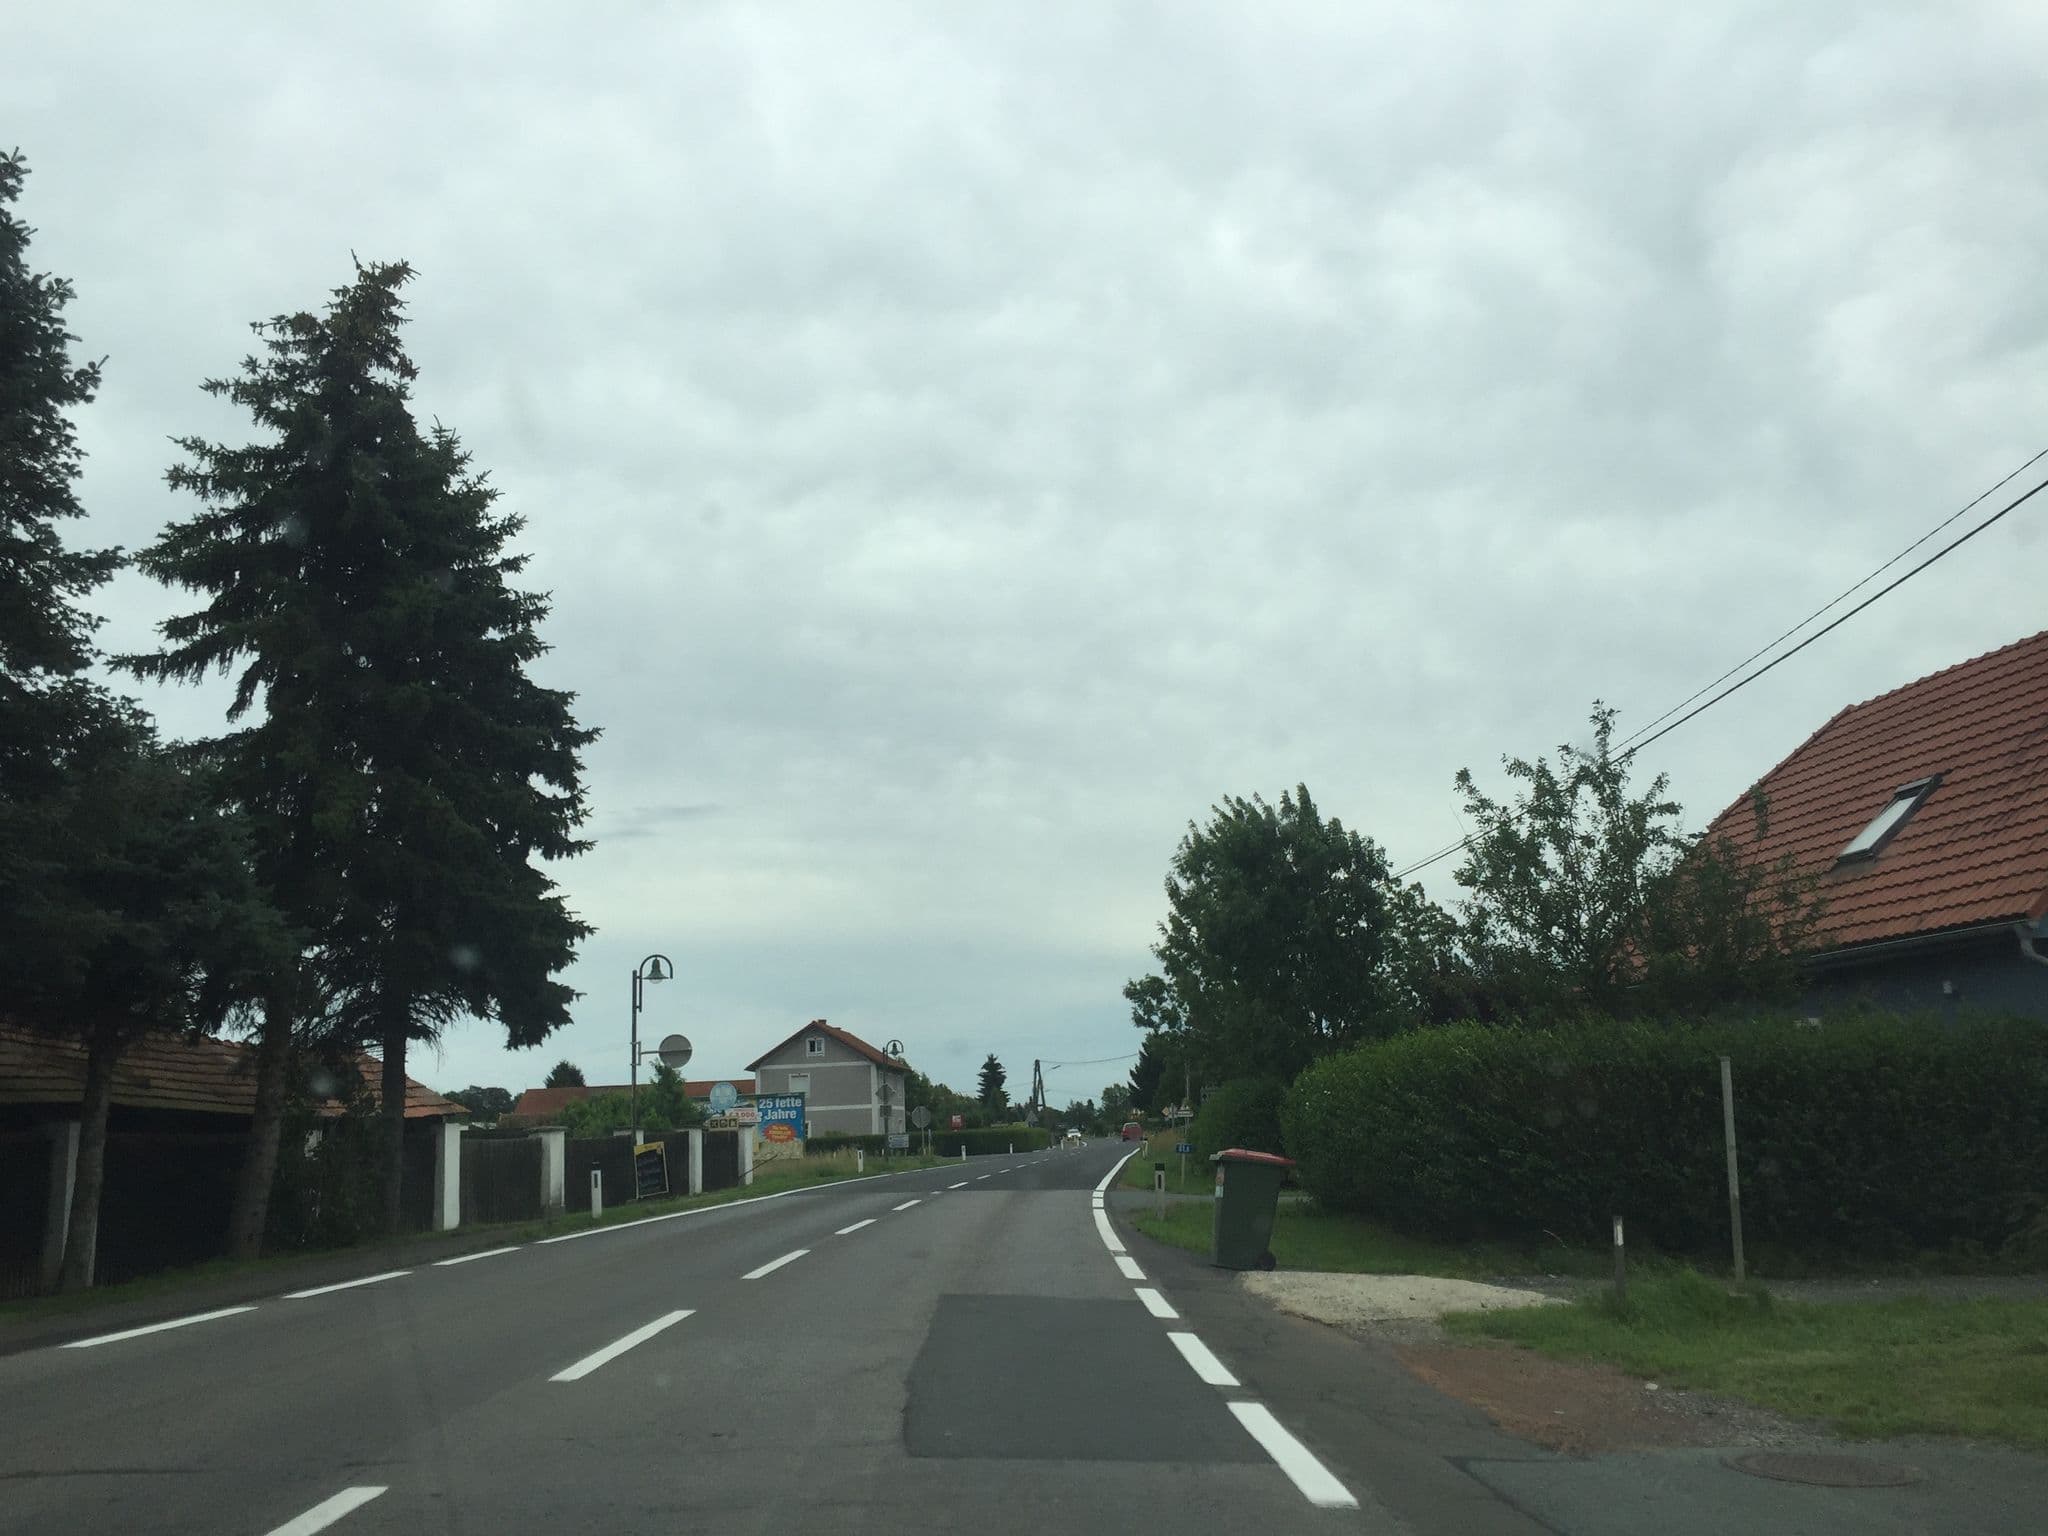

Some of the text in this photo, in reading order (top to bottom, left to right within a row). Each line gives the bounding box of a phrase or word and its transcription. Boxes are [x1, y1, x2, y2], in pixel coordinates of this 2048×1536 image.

[759, 1097, 802, 1109] 25 fette
[764, 1109, 797, 1120] Jahre
